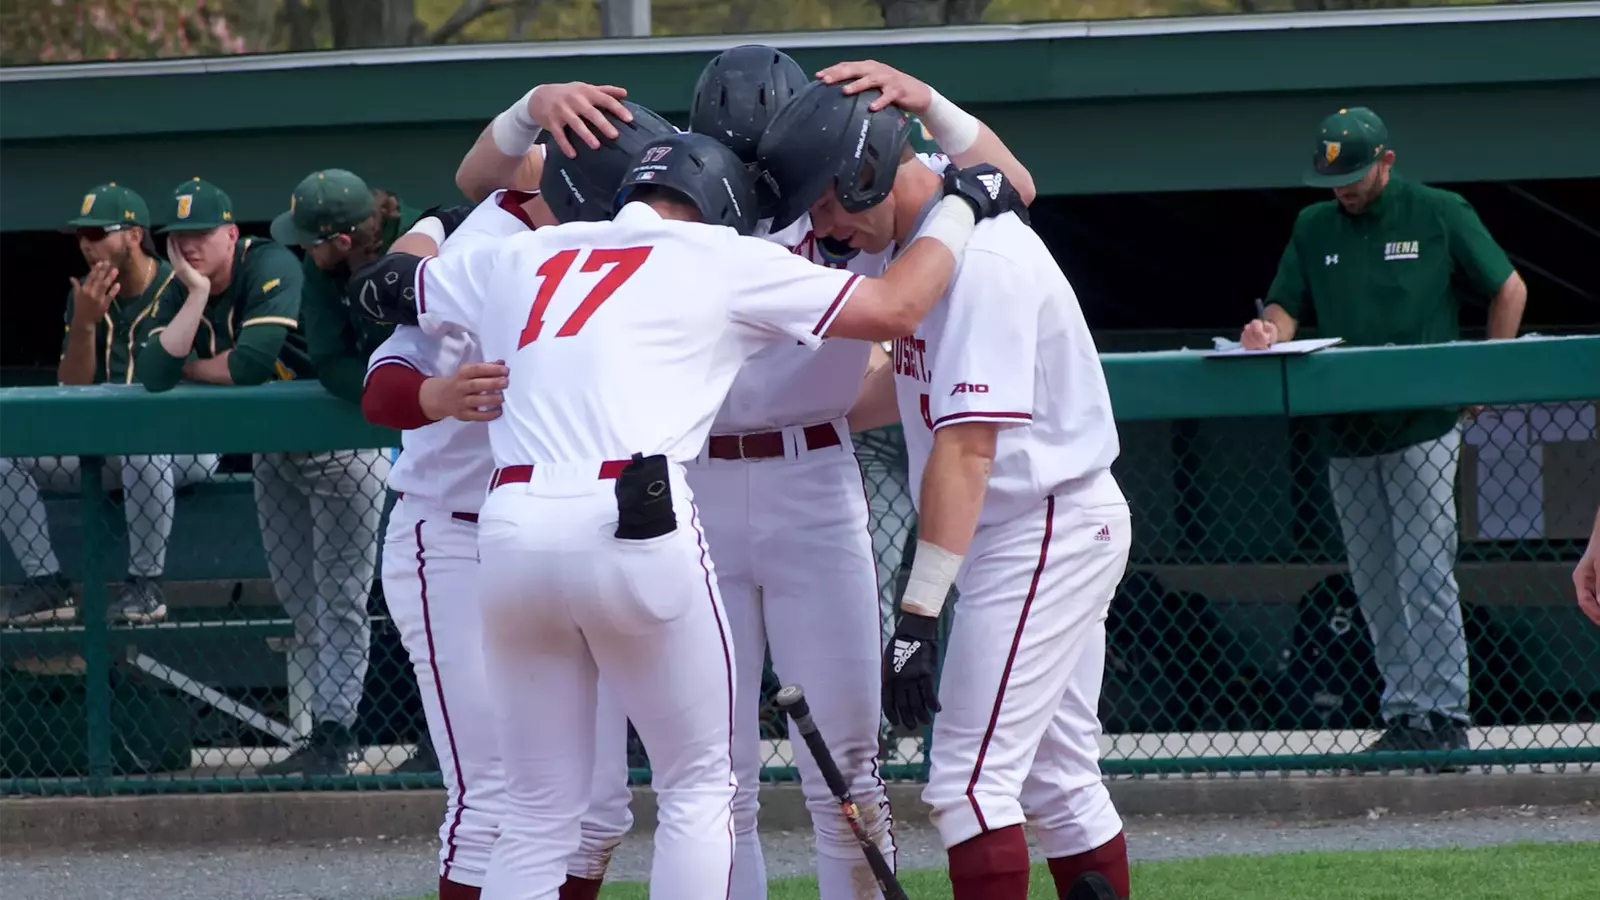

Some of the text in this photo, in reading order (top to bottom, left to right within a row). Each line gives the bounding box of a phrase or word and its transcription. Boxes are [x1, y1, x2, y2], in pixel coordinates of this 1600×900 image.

[641, 147, 673, 164] 17
[1384, 240, 1419, 255] SIENA
[517, 246, 655, 351] 17
[894, 641, 921, 673] adidas
